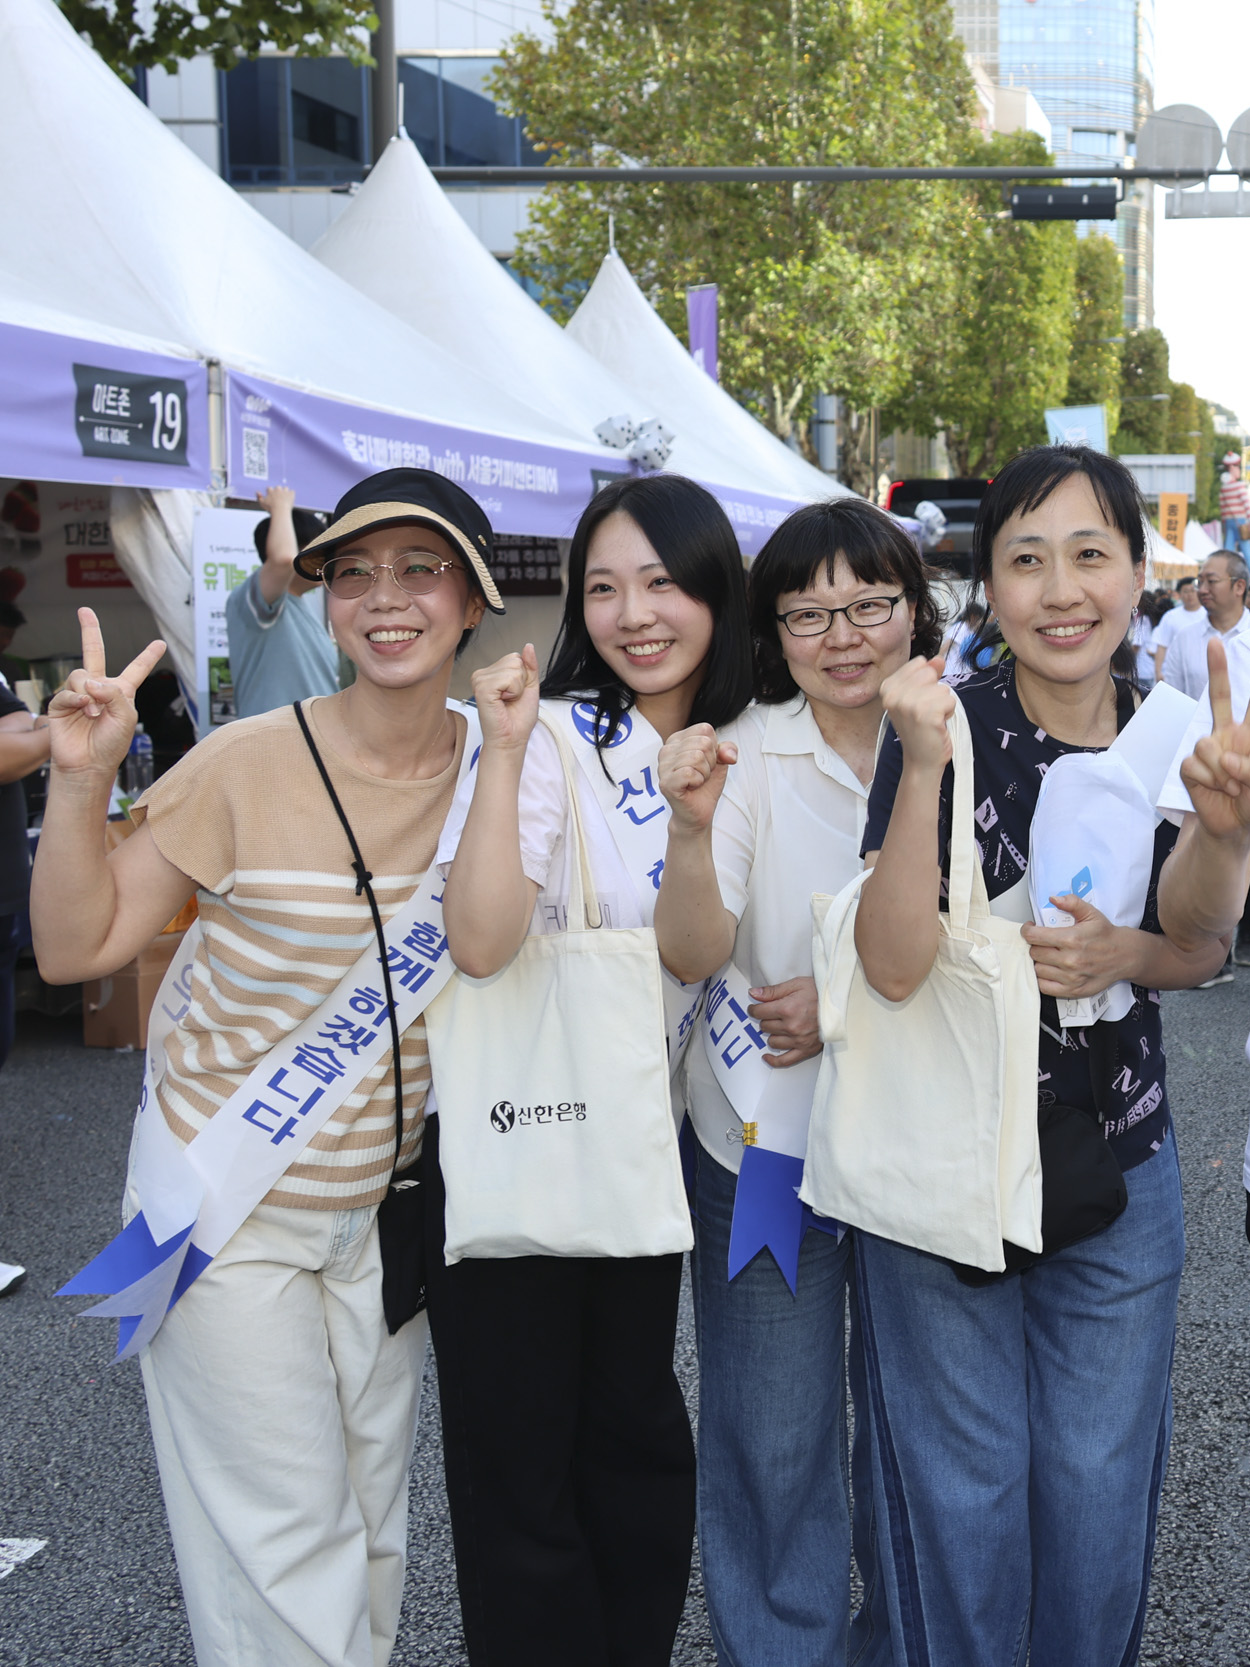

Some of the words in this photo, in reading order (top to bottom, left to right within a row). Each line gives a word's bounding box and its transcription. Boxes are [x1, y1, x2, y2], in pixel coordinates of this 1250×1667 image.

[92, 383, 131, 417] 아트존
[149, 391, 182, 450] 19
[433, 449, 466, 482] with
[64, 521, 110, 546] 대한
[377, 921, 448, 994] 함께
[242, 986, 399, 1145] 하겠습니다
[517, 1102, 587, 1126] 신한은행
